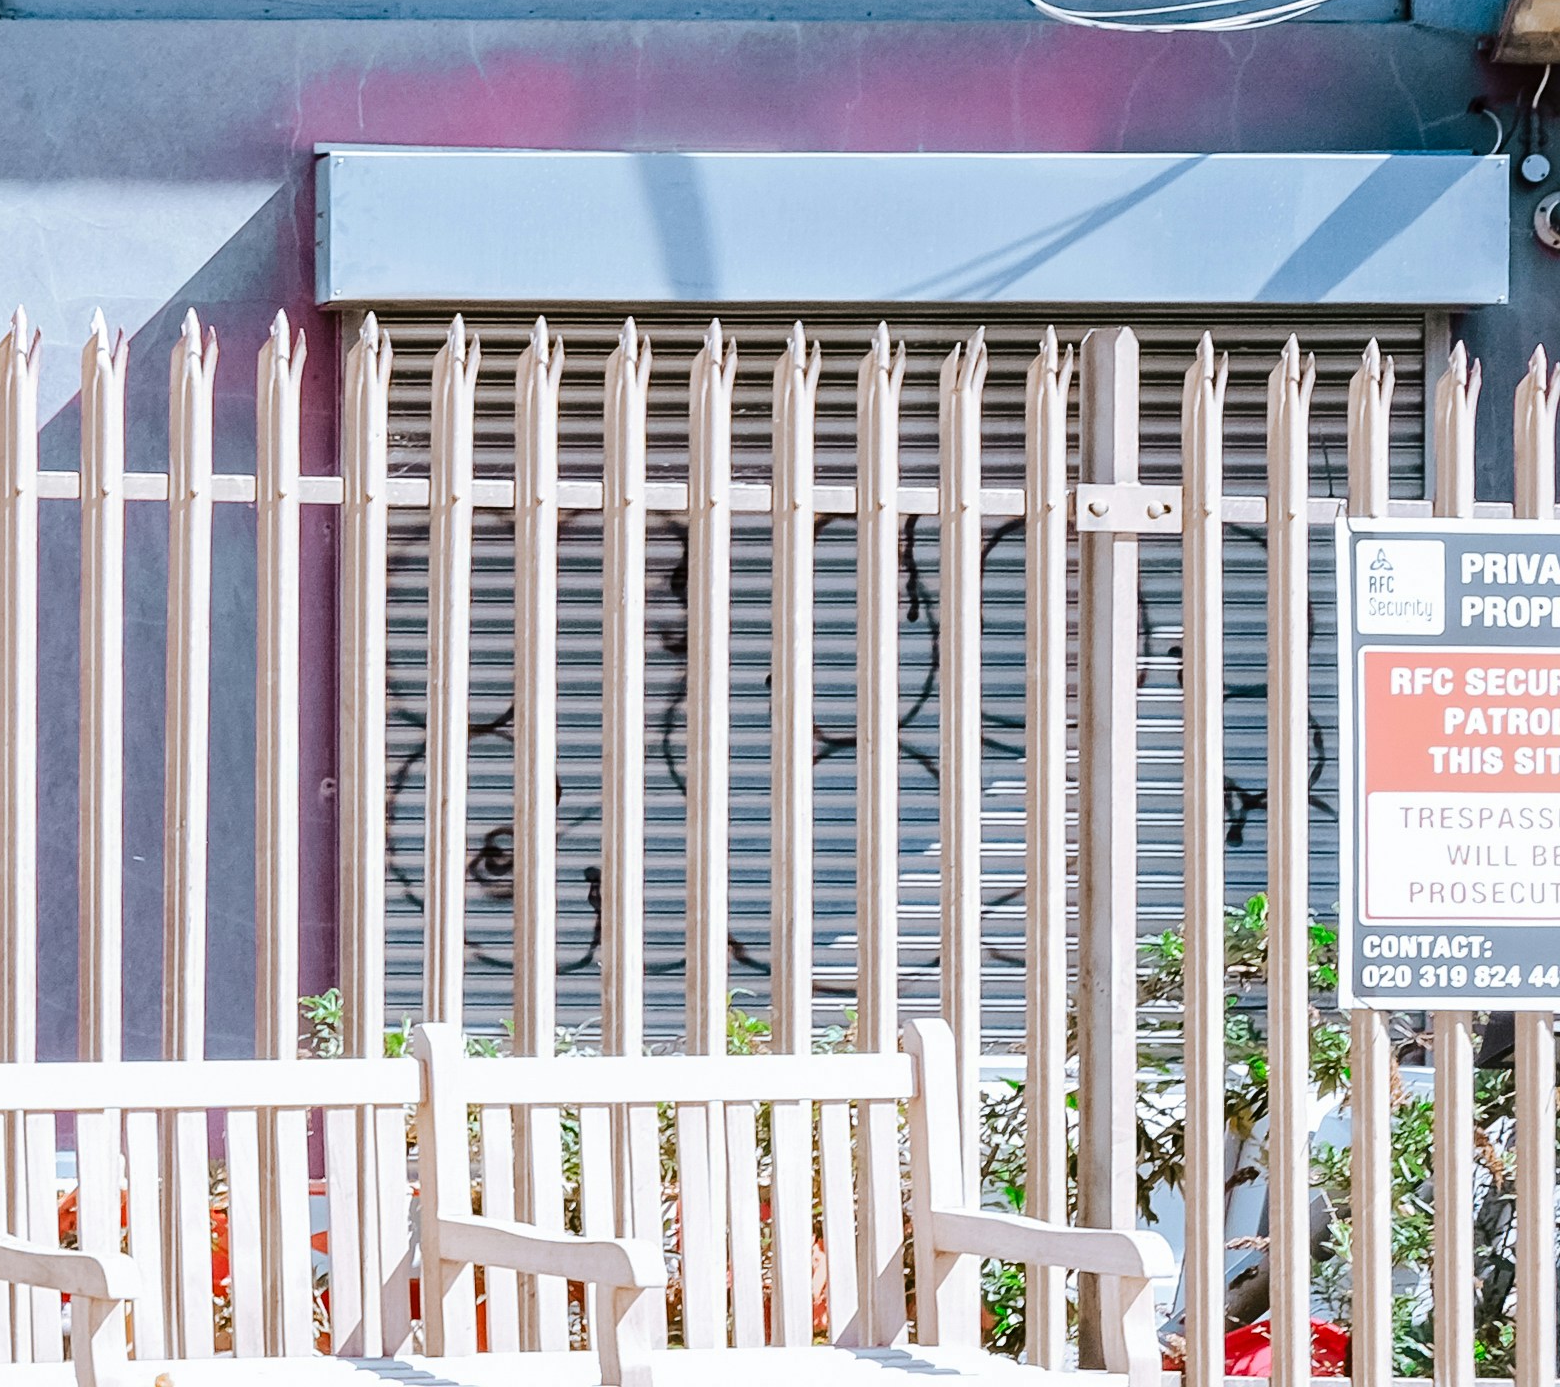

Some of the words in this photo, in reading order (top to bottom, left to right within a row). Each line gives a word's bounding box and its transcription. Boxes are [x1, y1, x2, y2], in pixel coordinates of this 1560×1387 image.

[1461, 553, 1560, 585] PRIVA
[1368, 575, 1395, 593] RFC
[1368, 597, 1434, 622] Security
[1390, 666, 1455, 696] RFC
[1427, 745, 1505, 775] THIS
[1513, 746, 1560, 775] SIT
[1399, 806, 1560, 830] TRESPASS
[1447, 843, 1518, 867] WILL
[1531, 844, 1560, 867] BE
[1408, 880, 1560, 905] PROSECUT
[1362, 934, 1494, 960] CONTACT:
[1361, 964, 1413, 989] 020
[1418, 964, 1469, 989] 319
[1473, 964, 1523, 989] 824
[1527, 964, 1560, 989] 44
